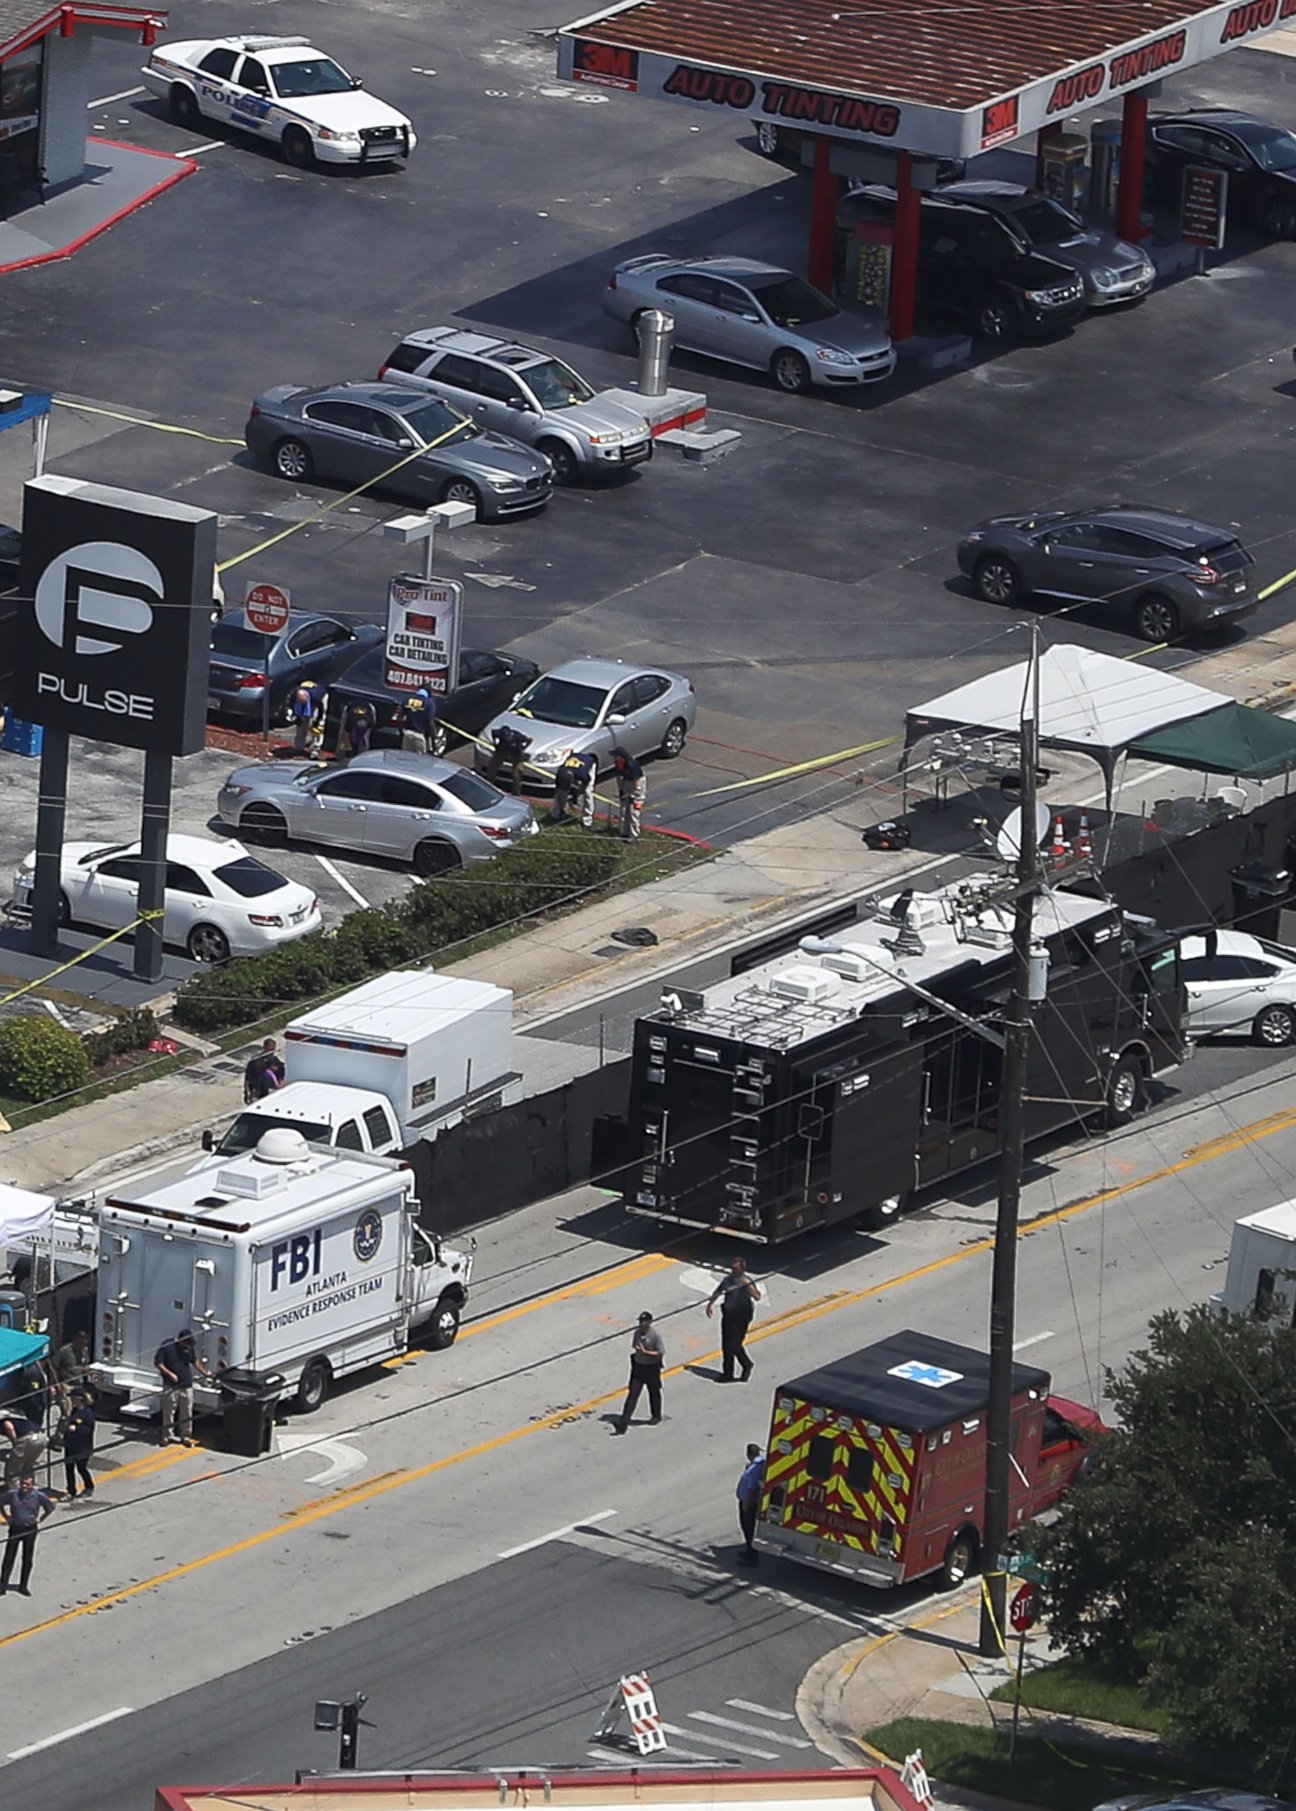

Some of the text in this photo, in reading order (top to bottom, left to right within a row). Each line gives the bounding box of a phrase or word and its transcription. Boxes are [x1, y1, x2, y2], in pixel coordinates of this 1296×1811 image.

[1220, 0, 1278, 43] AUTO
[582, 43, 631, 77] 3M
[1046, 29, 1187, 114] AUTO TINTING
[663, 64, 900, 137] AUTO TINTING
[986, 98, 1016, 134] 3M
[252, 590, 284, 606] DO NOT
[395, 586, 448, 602] Pro Tint
[253, 613, 280, 626] ENTER
[388, 645, 448, 665] CAR DETAILING
[394, 633, 445, 652] CAR TINTING
[37, 671, 155, 721] PULSE
[270, 1228, 322, 1292] FBI
[306, 1271, 347, 1298] ATLANTA
[268, 1276, 383, 1331] EVIDENCE RESPONSE TEAM
[806, 1485, 825, 1503] 171
